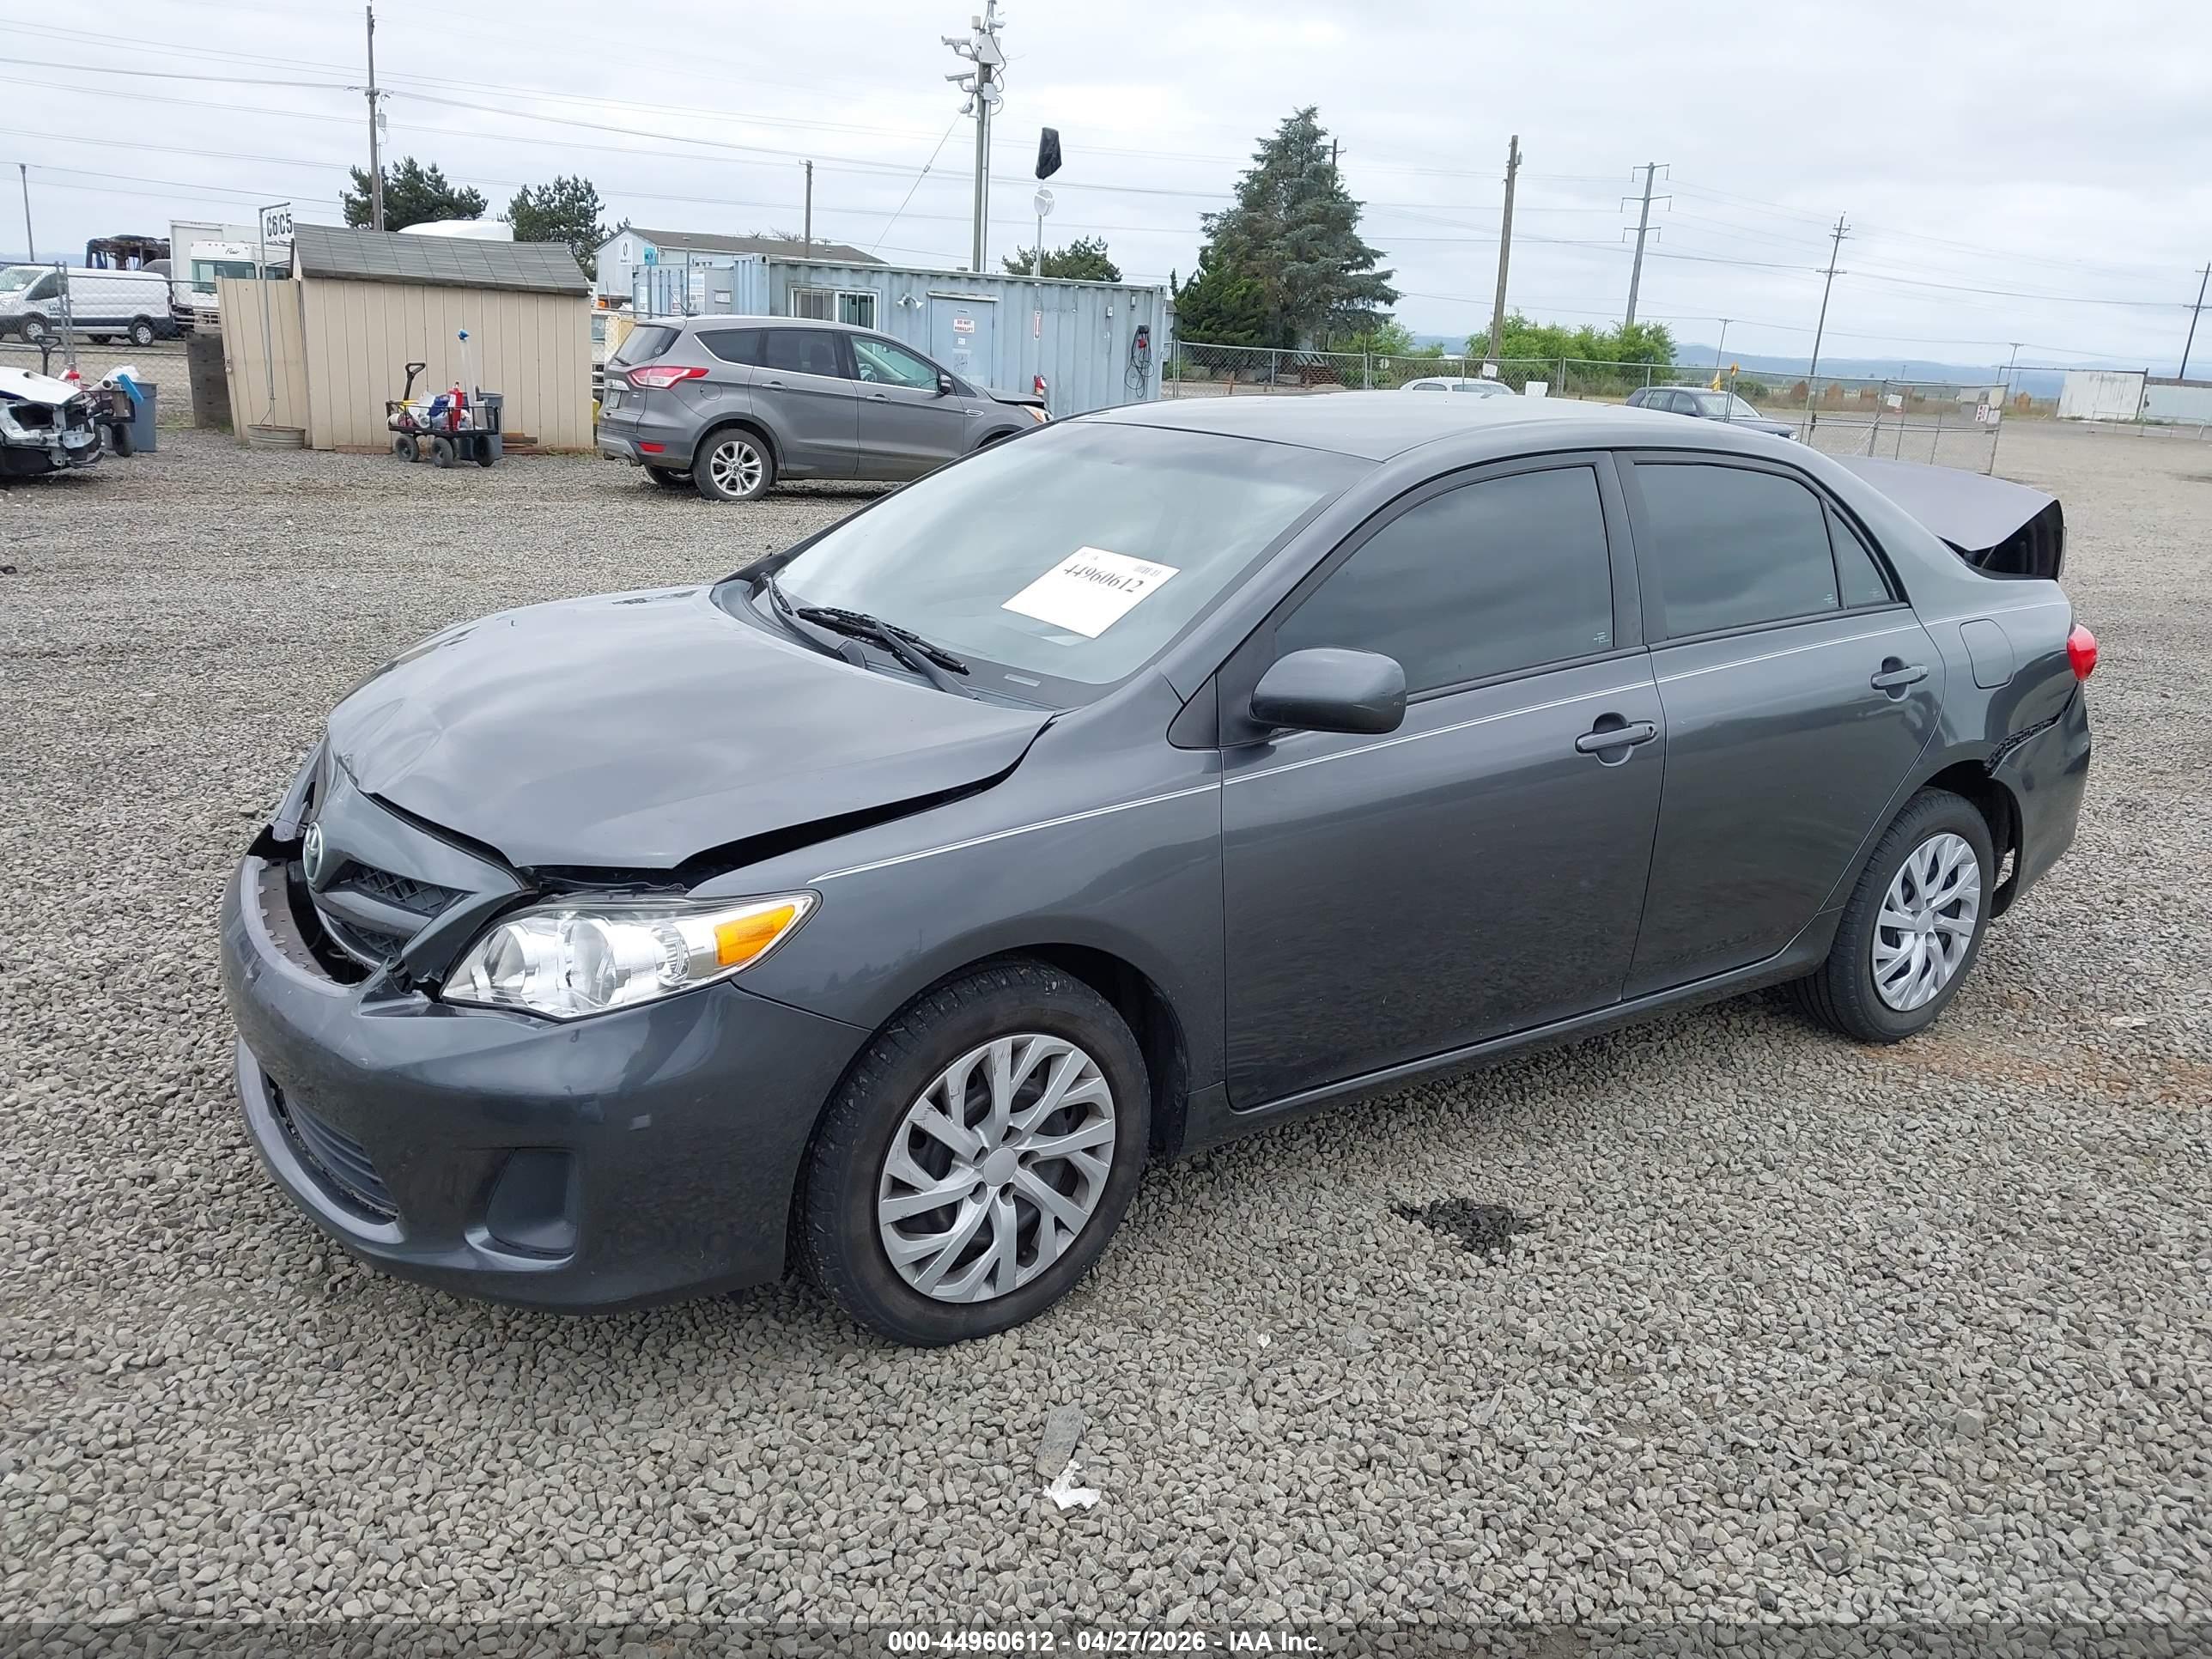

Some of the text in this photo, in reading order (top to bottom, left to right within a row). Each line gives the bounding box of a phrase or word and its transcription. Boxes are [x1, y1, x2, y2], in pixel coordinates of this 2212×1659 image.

[266, 212, 293, 237] C6 C5
[1063, 563, 1144, 592] 44960612
